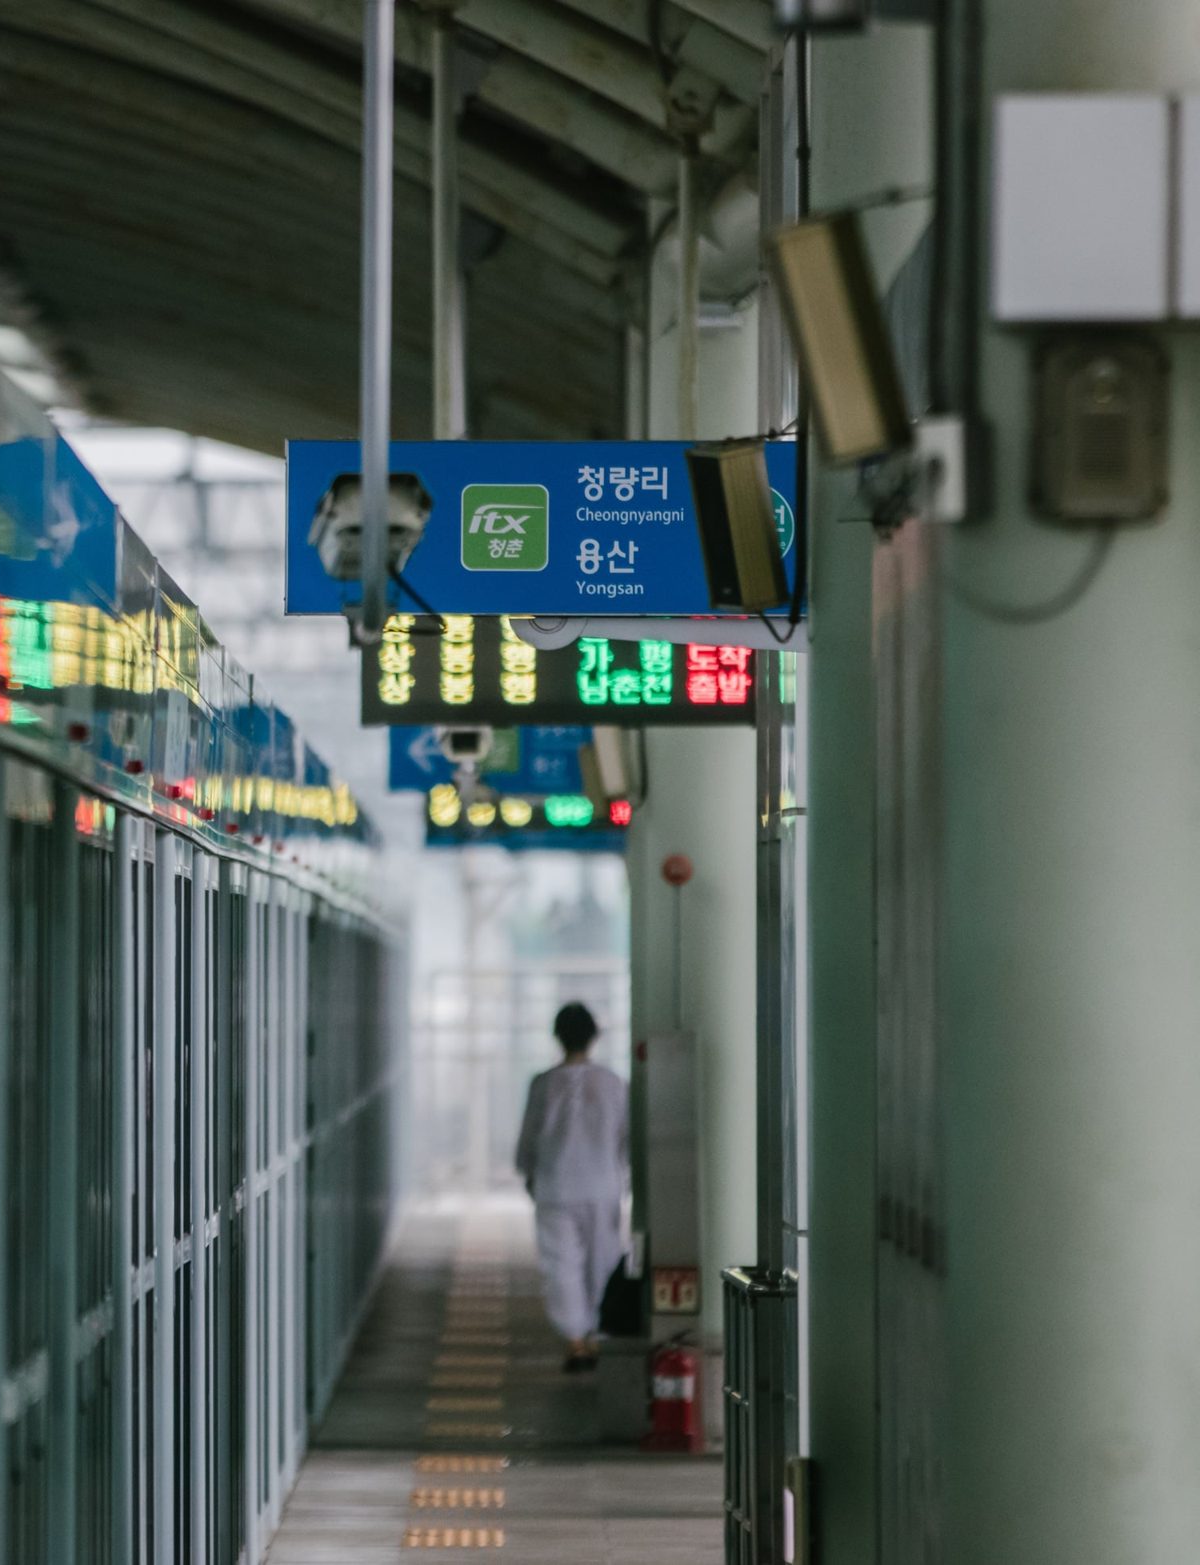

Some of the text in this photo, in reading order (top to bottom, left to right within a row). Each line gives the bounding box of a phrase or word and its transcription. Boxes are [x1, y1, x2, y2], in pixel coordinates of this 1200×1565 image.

[577, 465, 668, 501] 청량리
[576, 507, 685, 525] Cheongnyangni
[487, 539, 524, 558] 청춘
[576, 538, 639, 575] 용산
[576, 581, 644, 598] Yongsan
